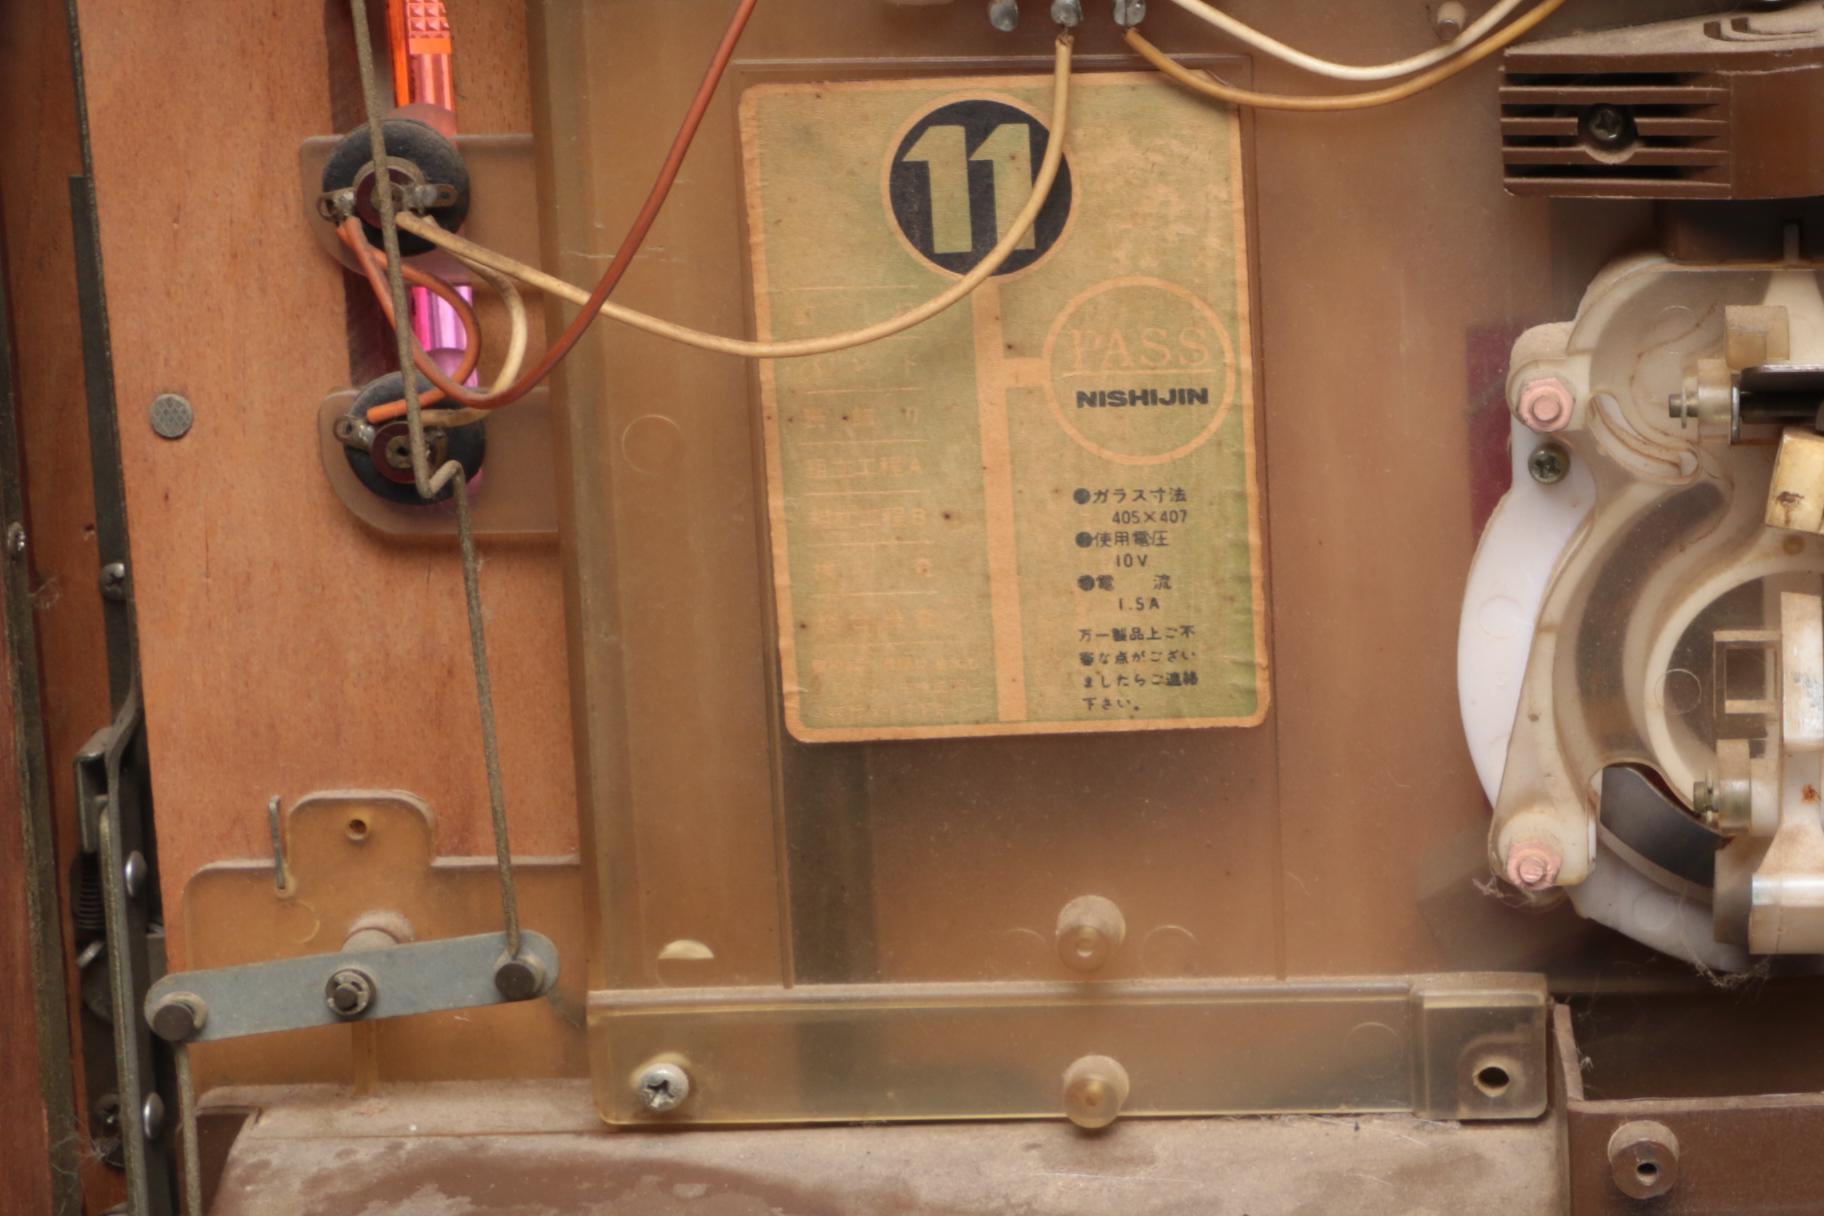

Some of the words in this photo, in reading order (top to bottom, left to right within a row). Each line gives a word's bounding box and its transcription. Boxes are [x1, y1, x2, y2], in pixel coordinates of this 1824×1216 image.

[902, 122, 1036, 254] 11
[1066, 326, 1210, 371] PASS
[1076, 387, 1208, 408] NISHIJIN
[1092, 487, 1187, 504] ガラス寸法
[1094, 530, 1169, 547] 使用電圧
[1119, 596, 1160, 612] 1.5A
[1082, 697, 1140, 712] 下さい。
